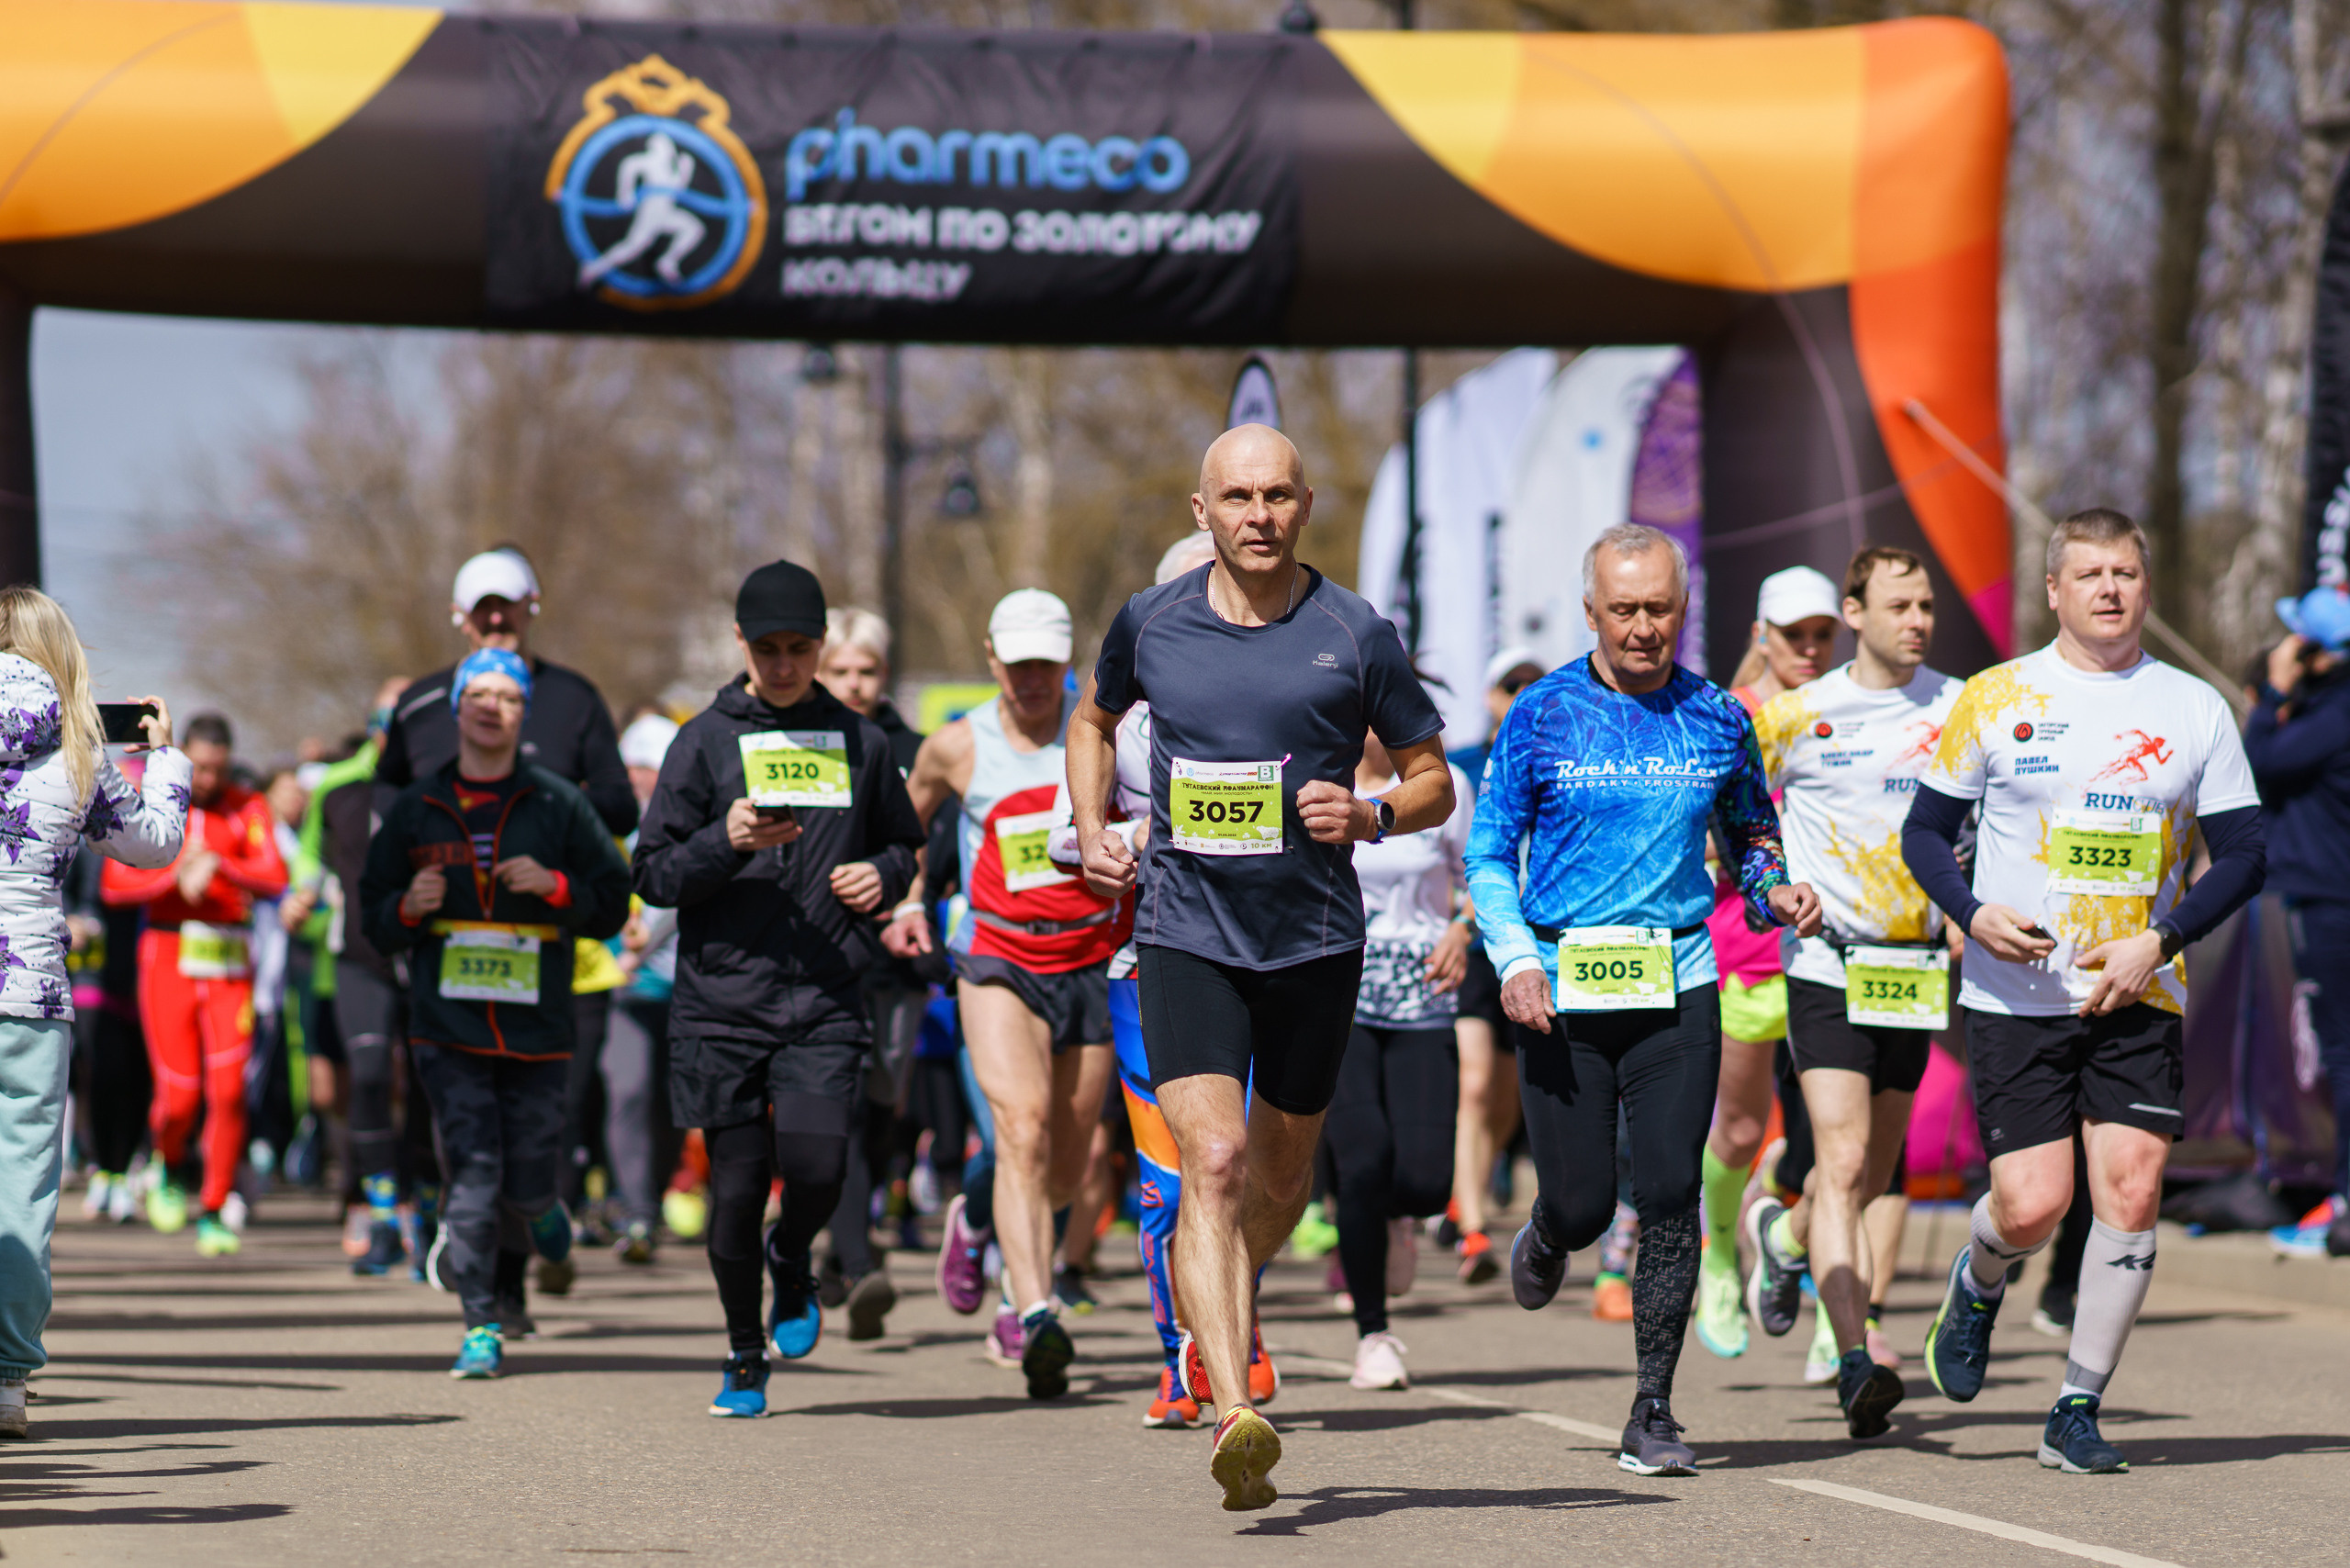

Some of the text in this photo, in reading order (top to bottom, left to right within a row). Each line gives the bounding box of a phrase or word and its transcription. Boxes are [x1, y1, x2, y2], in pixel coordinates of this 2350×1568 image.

[786, 106, 1190, 202] pharmeco
[783, 204, 1262, 256] БЕГОМ ПО ЗОЛОТОМУ
[781, 256, 972, 303] КОЛЬЦУ
[2015, 756, 2048, 766] ПАВЕЛ
[766, 763, 819, 779] 3120
[2015, 765, 2059, 777] ПУШКИН
[1182, 782, 1221, 791] ТУТАЕВСКИЙ
[1557, 779, 1628, 790] BARDAKY
[1883, 778, 1919, 793] RUN
[1189, 800, 1264, 823] 3057
[1019, 844, 1046, 863] 32
[2068, 846, 2132, 868] 3323
[459, 958, 511, 977] 3373
[1574, 960, 1643, 981] 3005
[1862, 980, 1918, 1002] 3324
